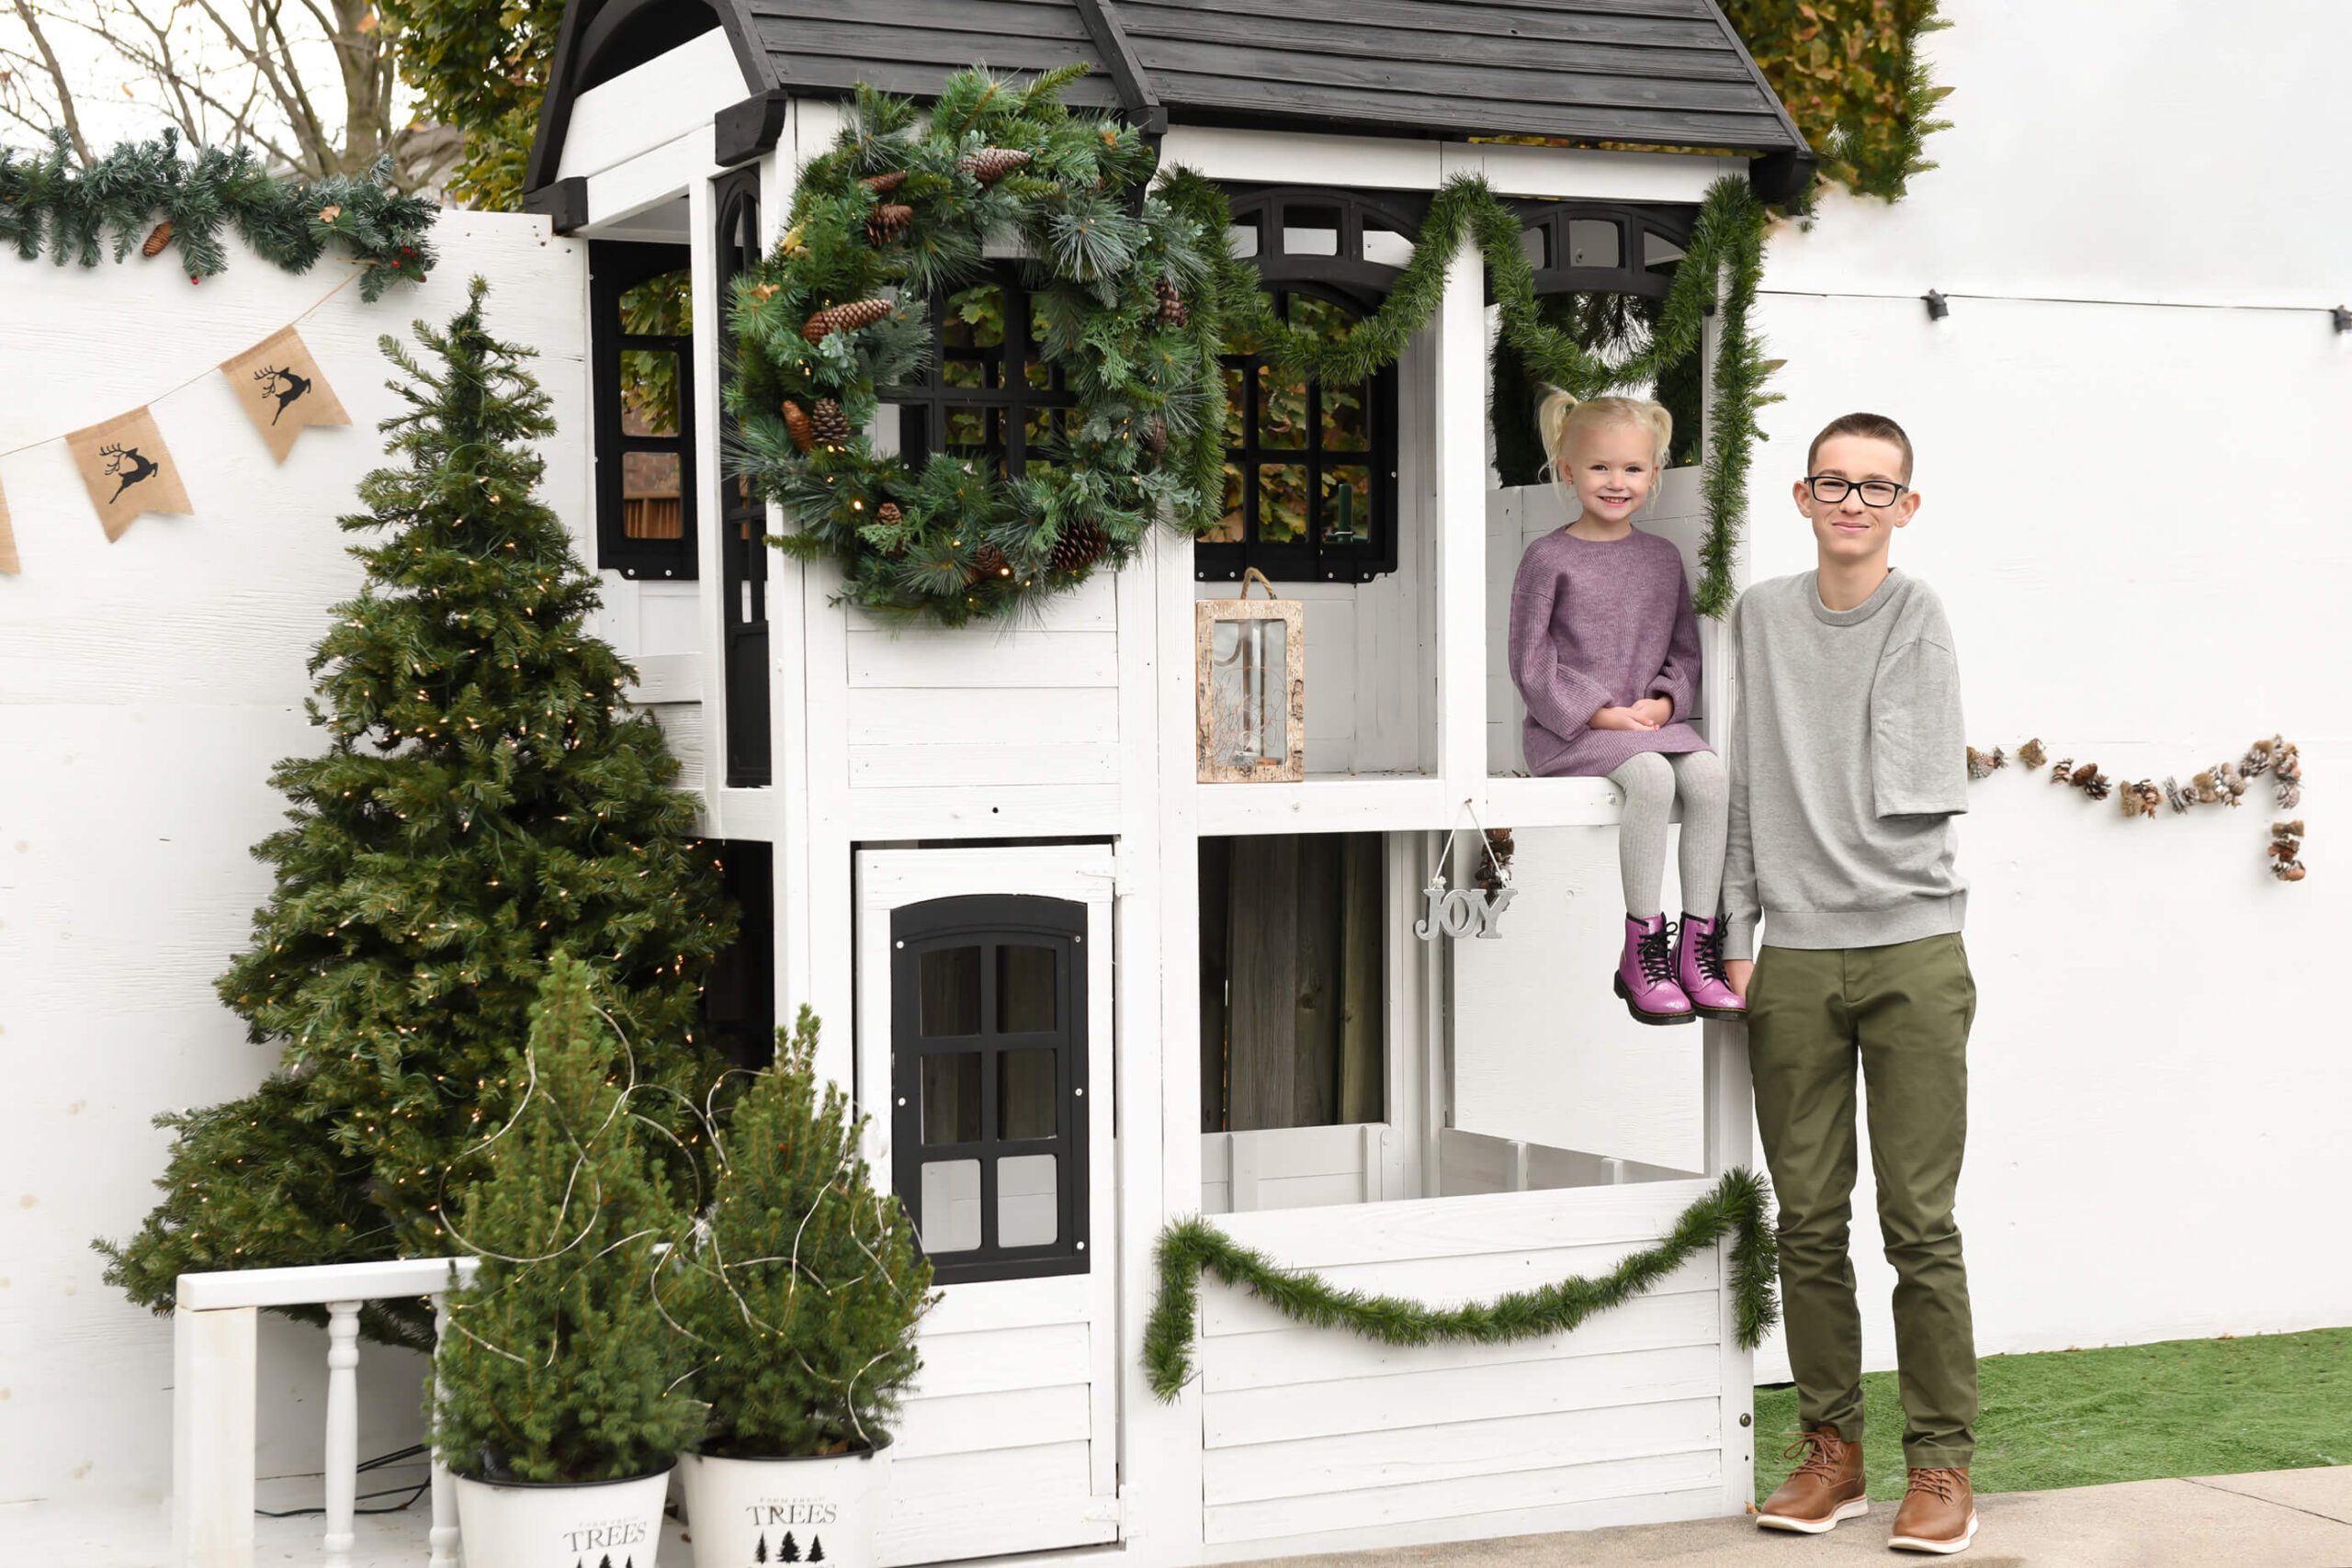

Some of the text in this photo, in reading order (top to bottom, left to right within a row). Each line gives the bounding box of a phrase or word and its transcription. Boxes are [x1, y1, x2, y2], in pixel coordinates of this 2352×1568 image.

[1413, 888, 1518, 940] JOY
[746, 1504, 837, 1525] TREES
[562, 1520, 647, 1551] TREES
